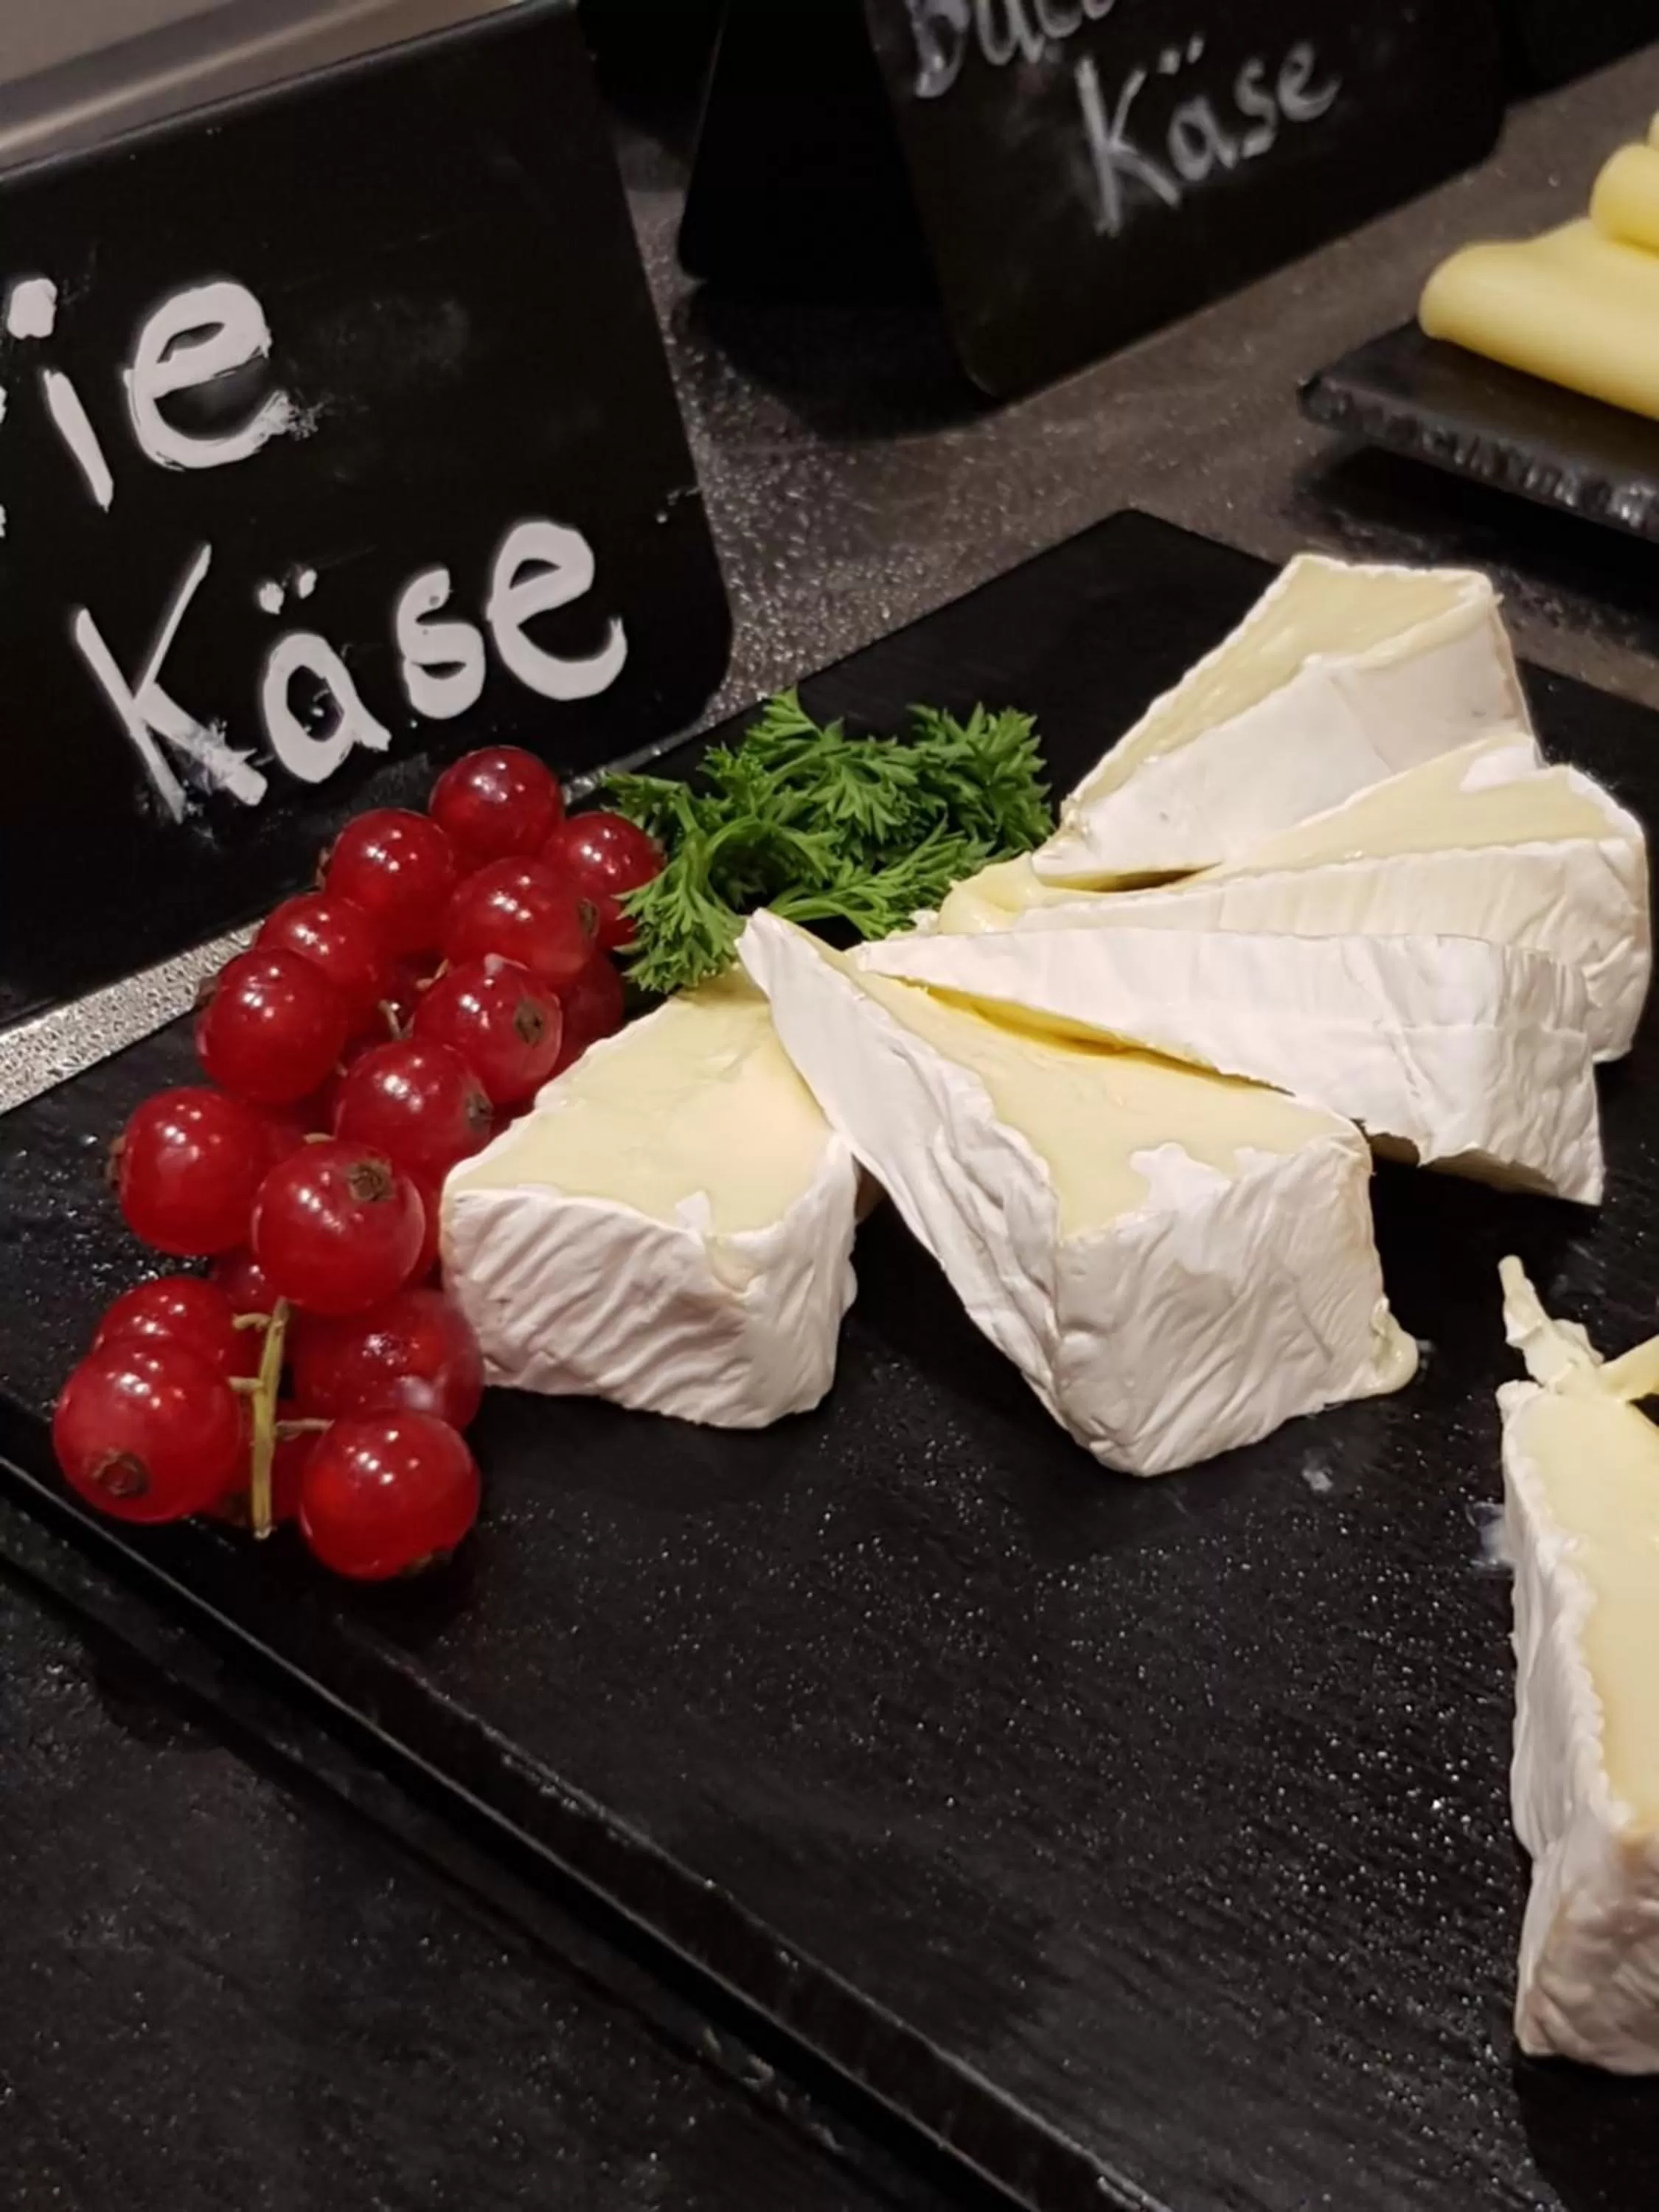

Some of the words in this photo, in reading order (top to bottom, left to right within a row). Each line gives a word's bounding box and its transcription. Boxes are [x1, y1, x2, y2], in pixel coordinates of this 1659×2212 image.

[1074, 34, 1343, 236] Käse
[0, 278, 296, 527] ie
[75, 521, 628, 823] Käse
